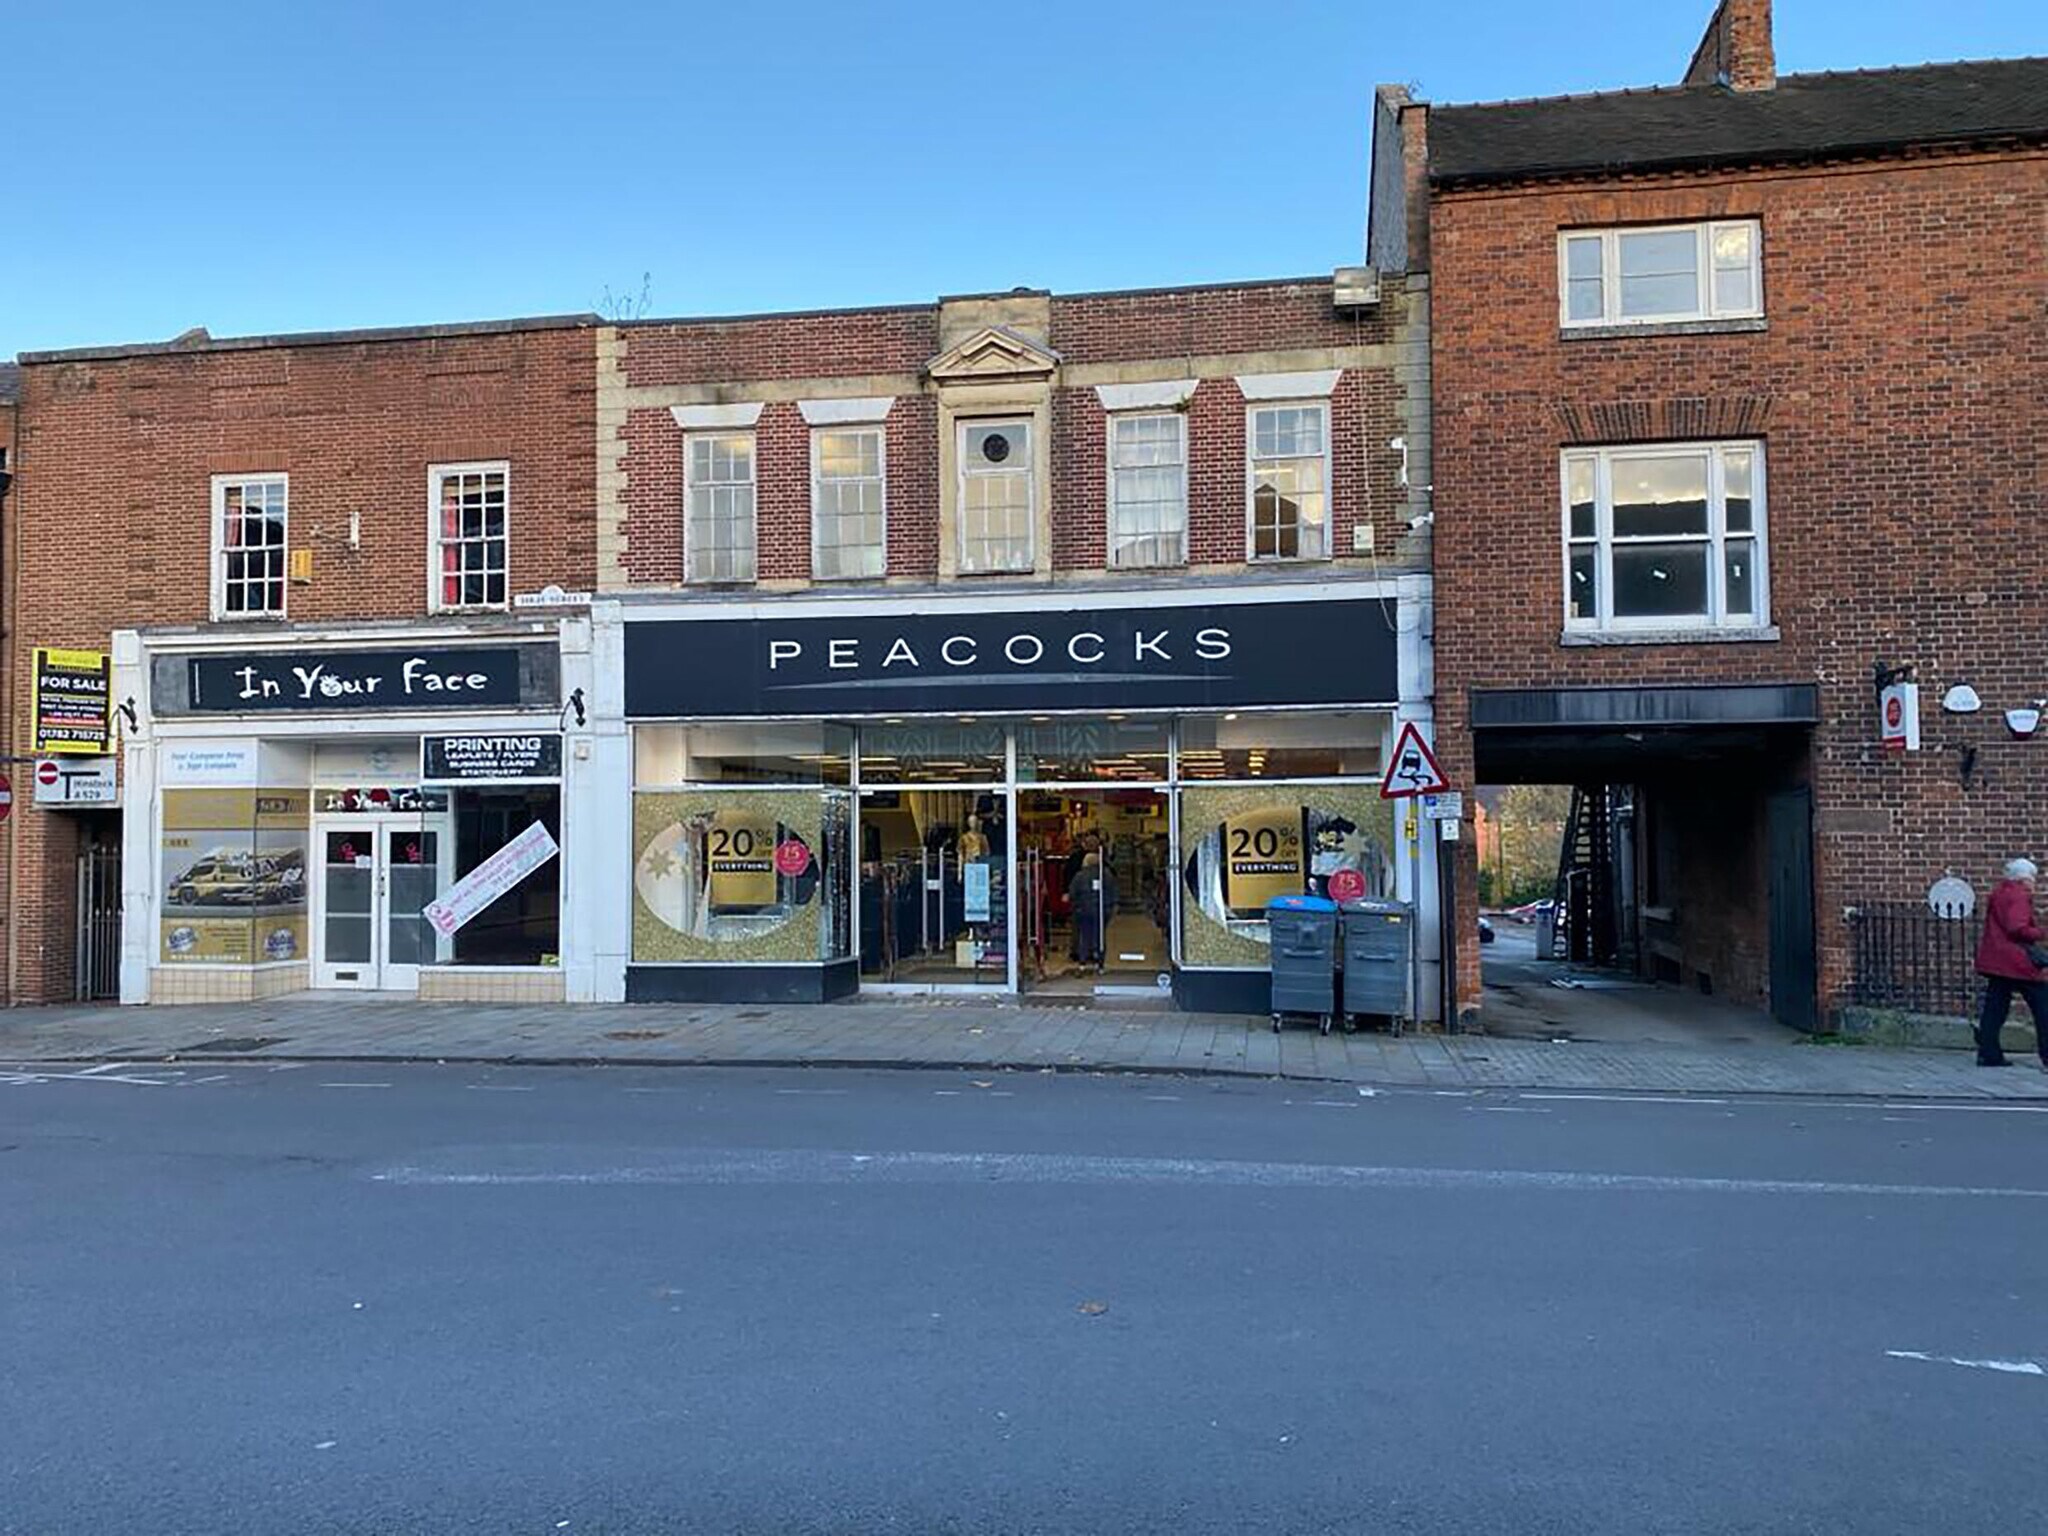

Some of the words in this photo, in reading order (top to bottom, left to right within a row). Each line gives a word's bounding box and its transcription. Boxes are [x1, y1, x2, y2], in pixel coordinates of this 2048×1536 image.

[769, 629, 1231, 670] PEACOCKS
[41, 676, 71, 689] FOR
[72, 678, 107, 691] SALE
[235, 666, 281, 698] In
[293, 663, 383, 699] Your
[402, 657, 488, 694] Face
[39, 728, 70, 739] 01782
[443, 737, 542, 752] PRINTING
[445, 751, 495, 760] LEAFLETS
[503, 750, 540, 758] FLYERS
[449, 760, 499, 768] BUSINESS
[712, 829, 773, 858] 20%
[1231, 827, 1298, 858] 20%
[714, 862, 770, 871] EVERYTHING
[1234, 863, 1297, 873] EVERYTHING
